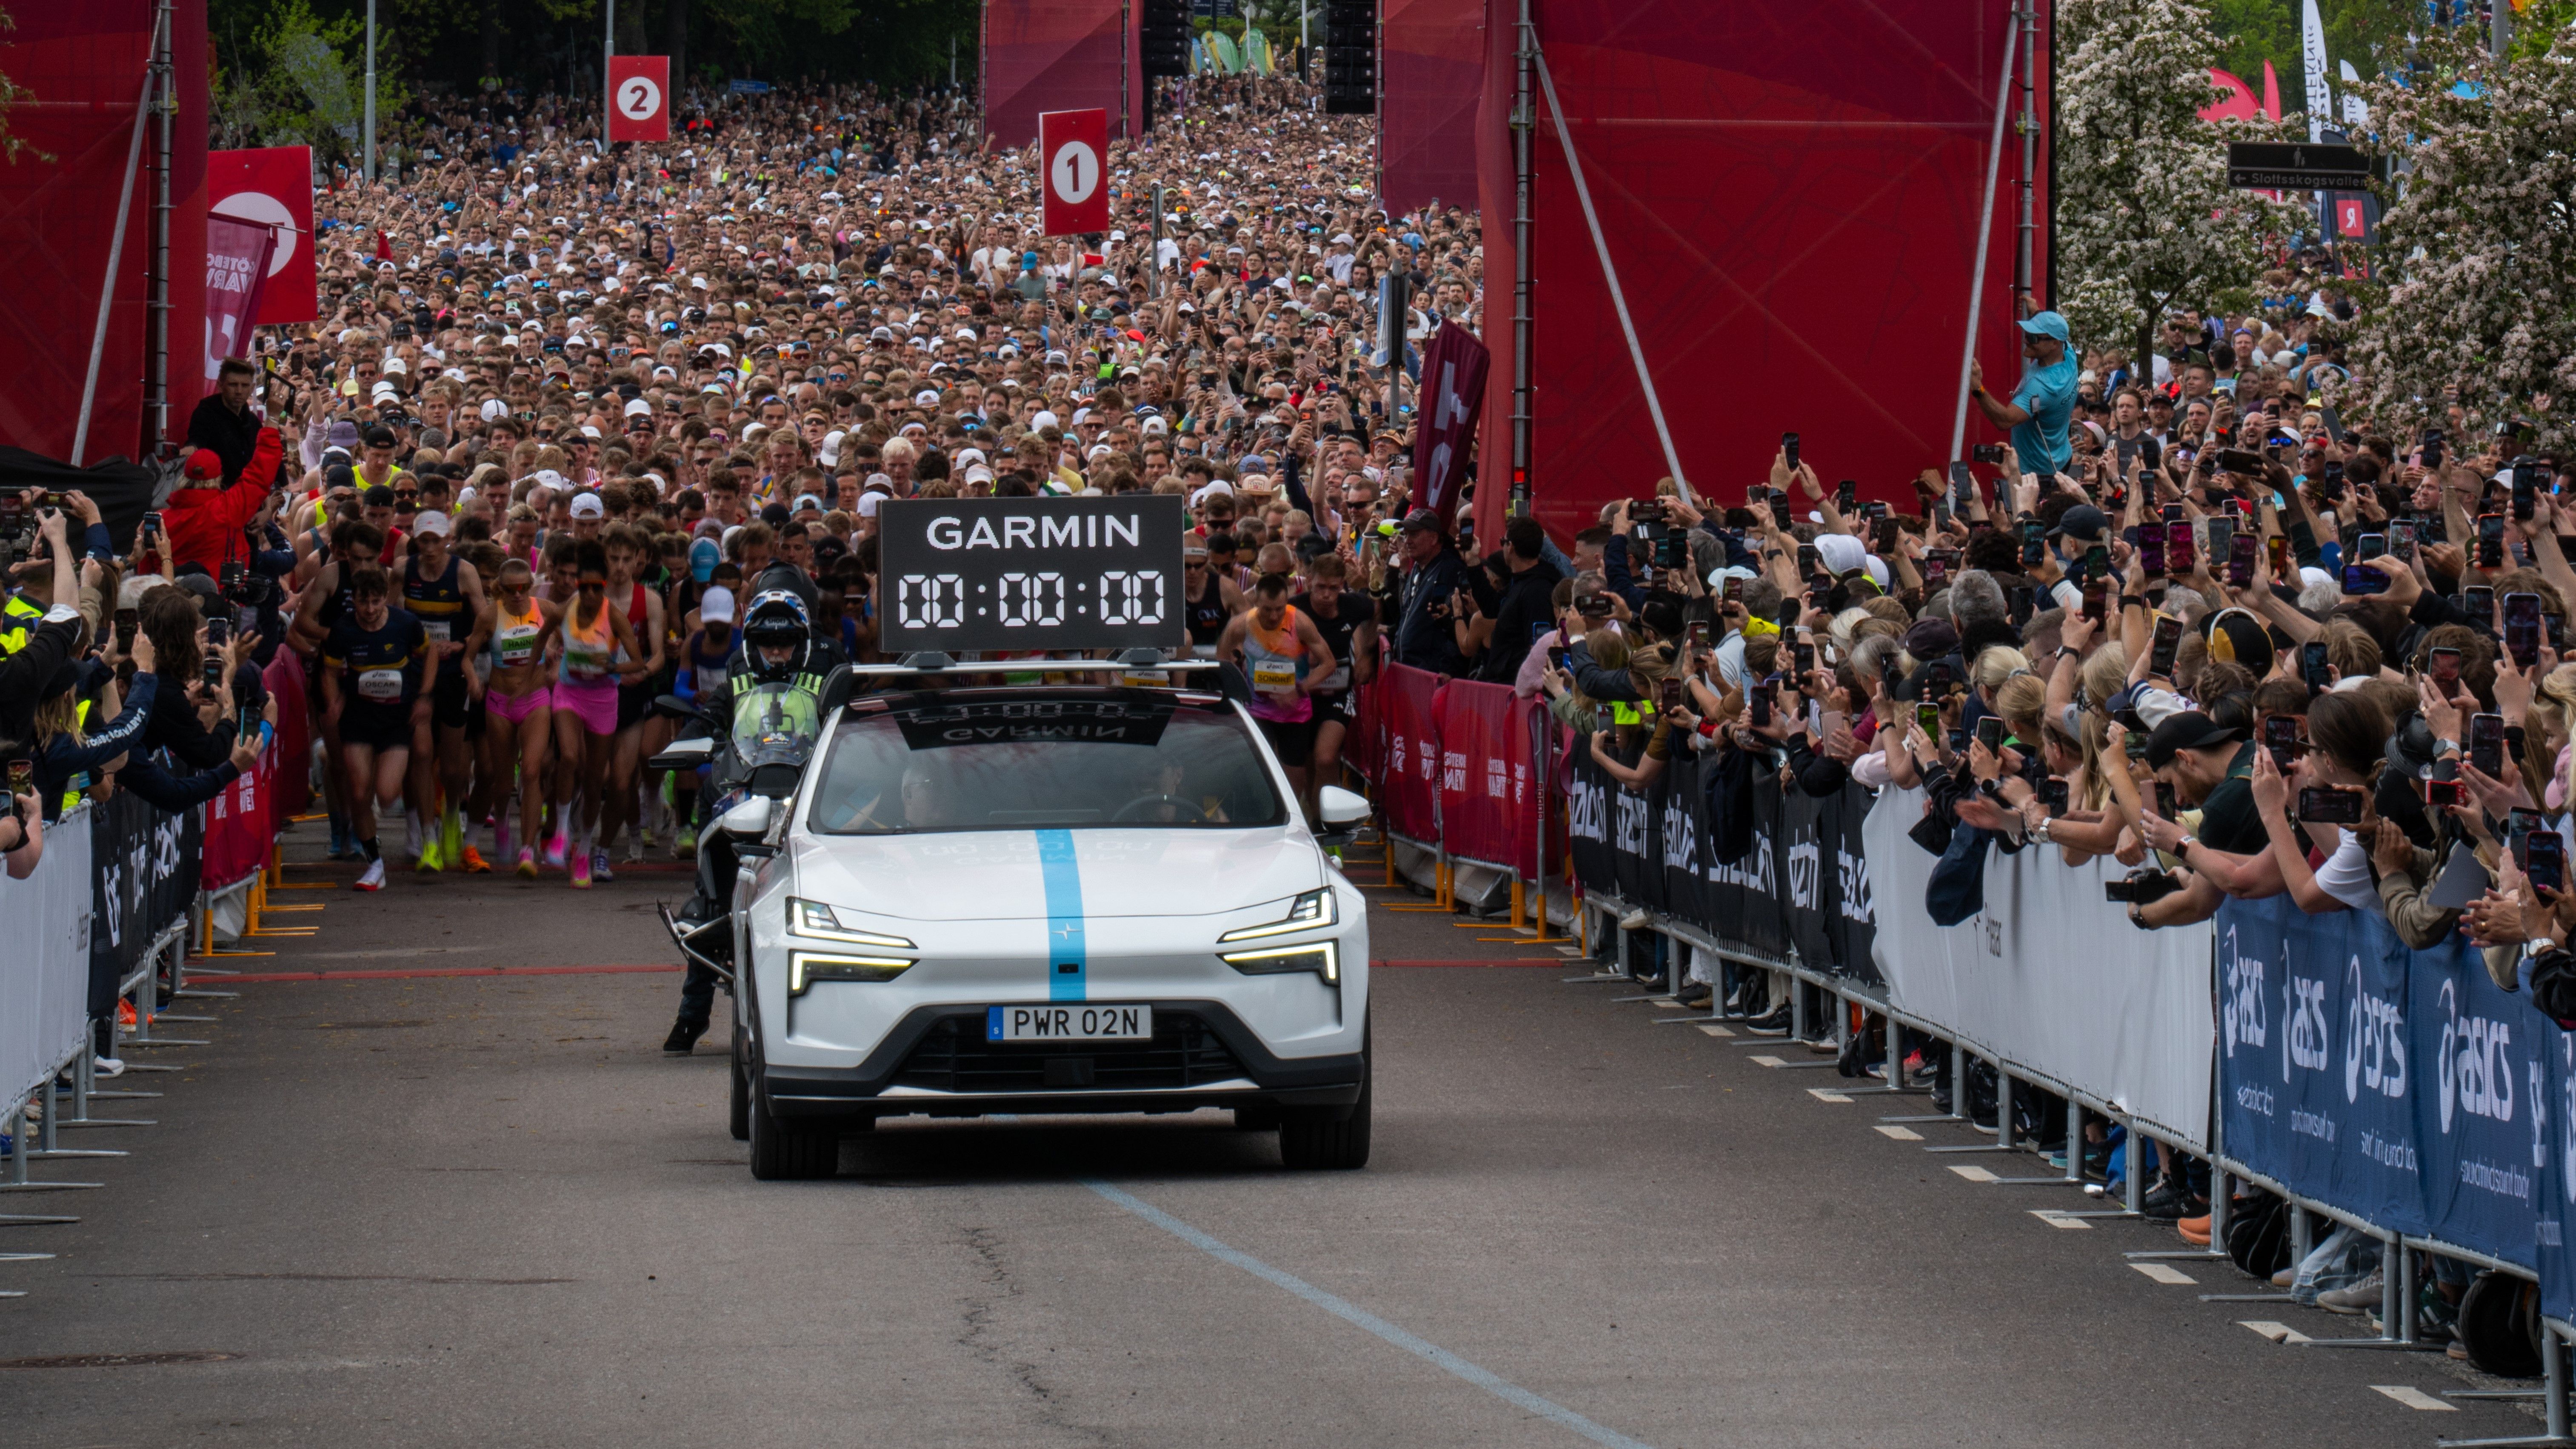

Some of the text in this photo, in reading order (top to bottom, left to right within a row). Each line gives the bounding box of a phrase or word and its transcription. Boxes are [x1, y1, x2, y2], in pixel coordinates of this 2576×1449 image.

[630, 85, 648, 112] 2
[1067, 153, 1079, 192] 1
[927, 514, 1139, 549] GARMIN
[899, 571, 1164, 628] 00:00:00
[1257, 674, 1292, 683] SONDRE
[1015, 1009, 1138, 1036] PWR 02N
[2456, 1016, 2513, 1122] asics
